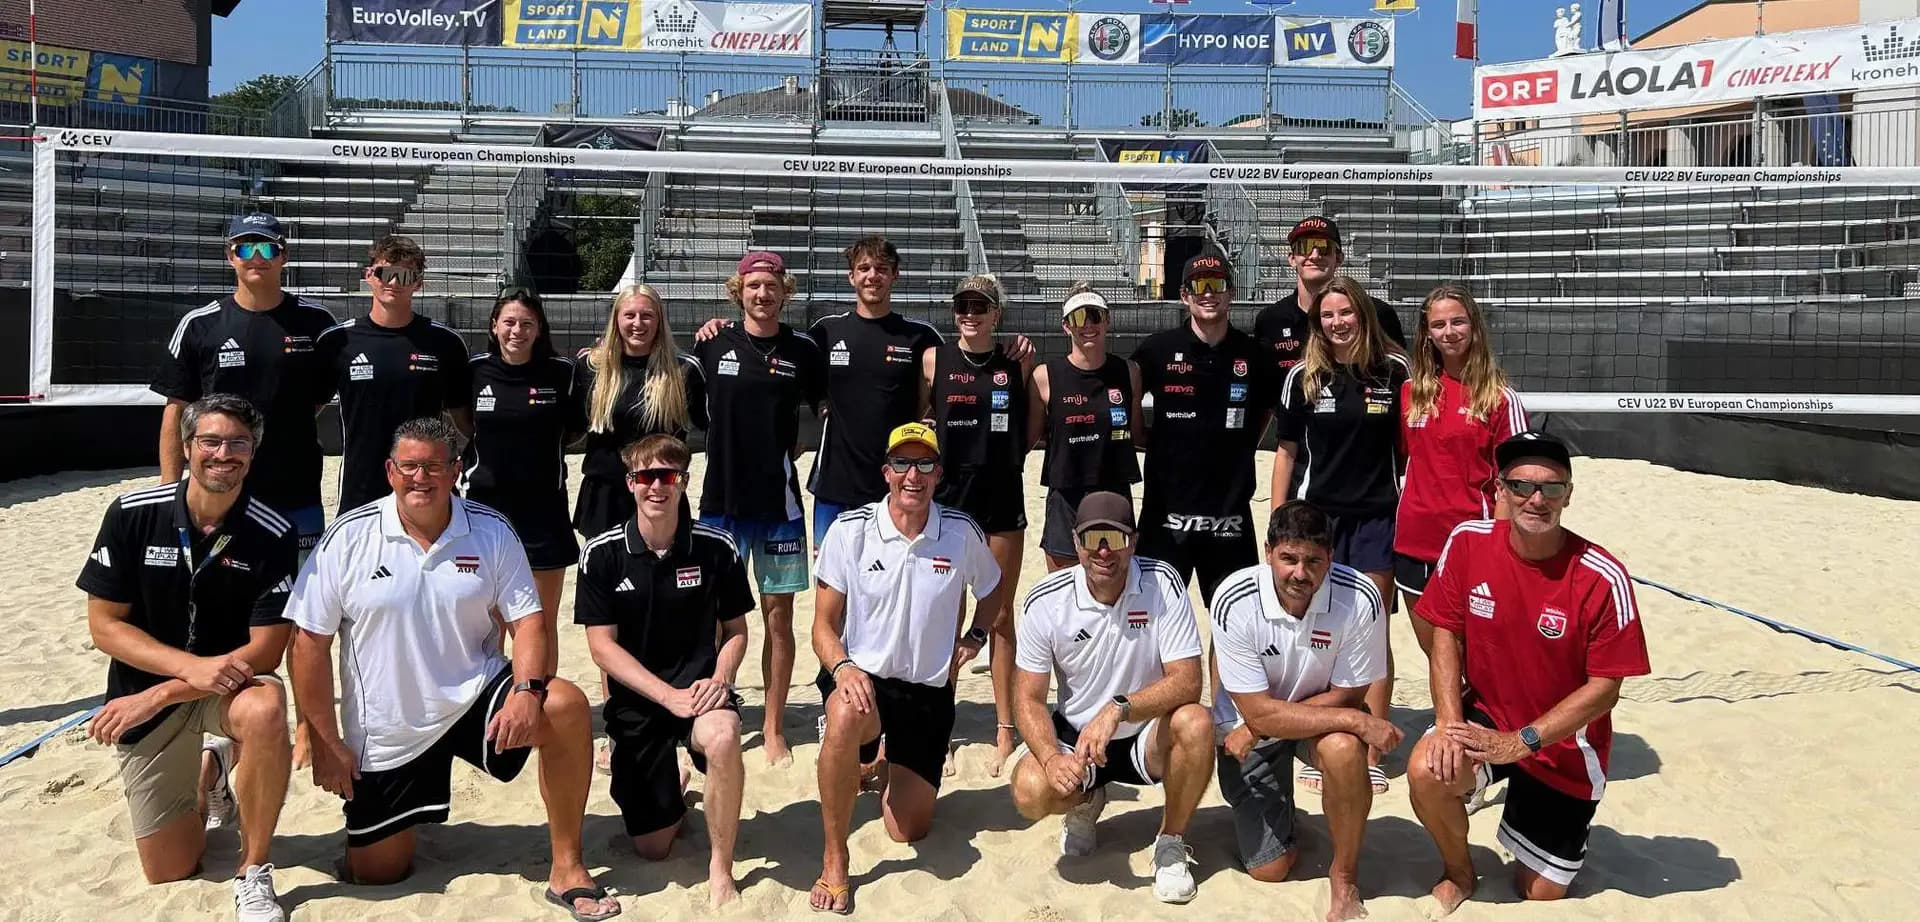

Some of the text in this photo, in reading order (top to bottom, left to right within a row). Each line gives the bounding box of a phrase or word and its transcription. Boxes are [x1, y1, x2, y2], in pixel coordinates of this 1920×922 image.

[527, 5, 575, 16] SPORT
[353, 7, 487, 31] EuroVolley.TV
[971, 18, 1017, 29] SPORT
[527, 28, 567, 40] LAND
[710, 29, 808, 51] CINEPLEXX
[647, 36, 704, 49] kronehit
[971, 42, 1009, 52] LAND
[1179, 34, 1270, 49] HYPO NOE
[1293, 32, 1328, 51] NV
[7, 48, 78, 69] SPORT
[1727, 55, 1843, 88] CINEPLEXX
[1487, 77, 1553, 102] ORF
[82, 135, 112, 145] CEV
[332, 144, 575, 165] CEV U22 BV European Championships
[1124, 153, 1155, 161] SPORT
[783, 160, 1012, 178] CEV U22 BV European Championships
[1209, 168, 1433, 182] CEV U22 BV European Championships
[1625, 171, 1842, 183] CEV U22 BV European Championships
[1617, 398, 1834, 412] CEV U22 BV European Championships
[1162, 512, 1243, 532] STEYR
[1311, 642, 1330, 650] AUT
